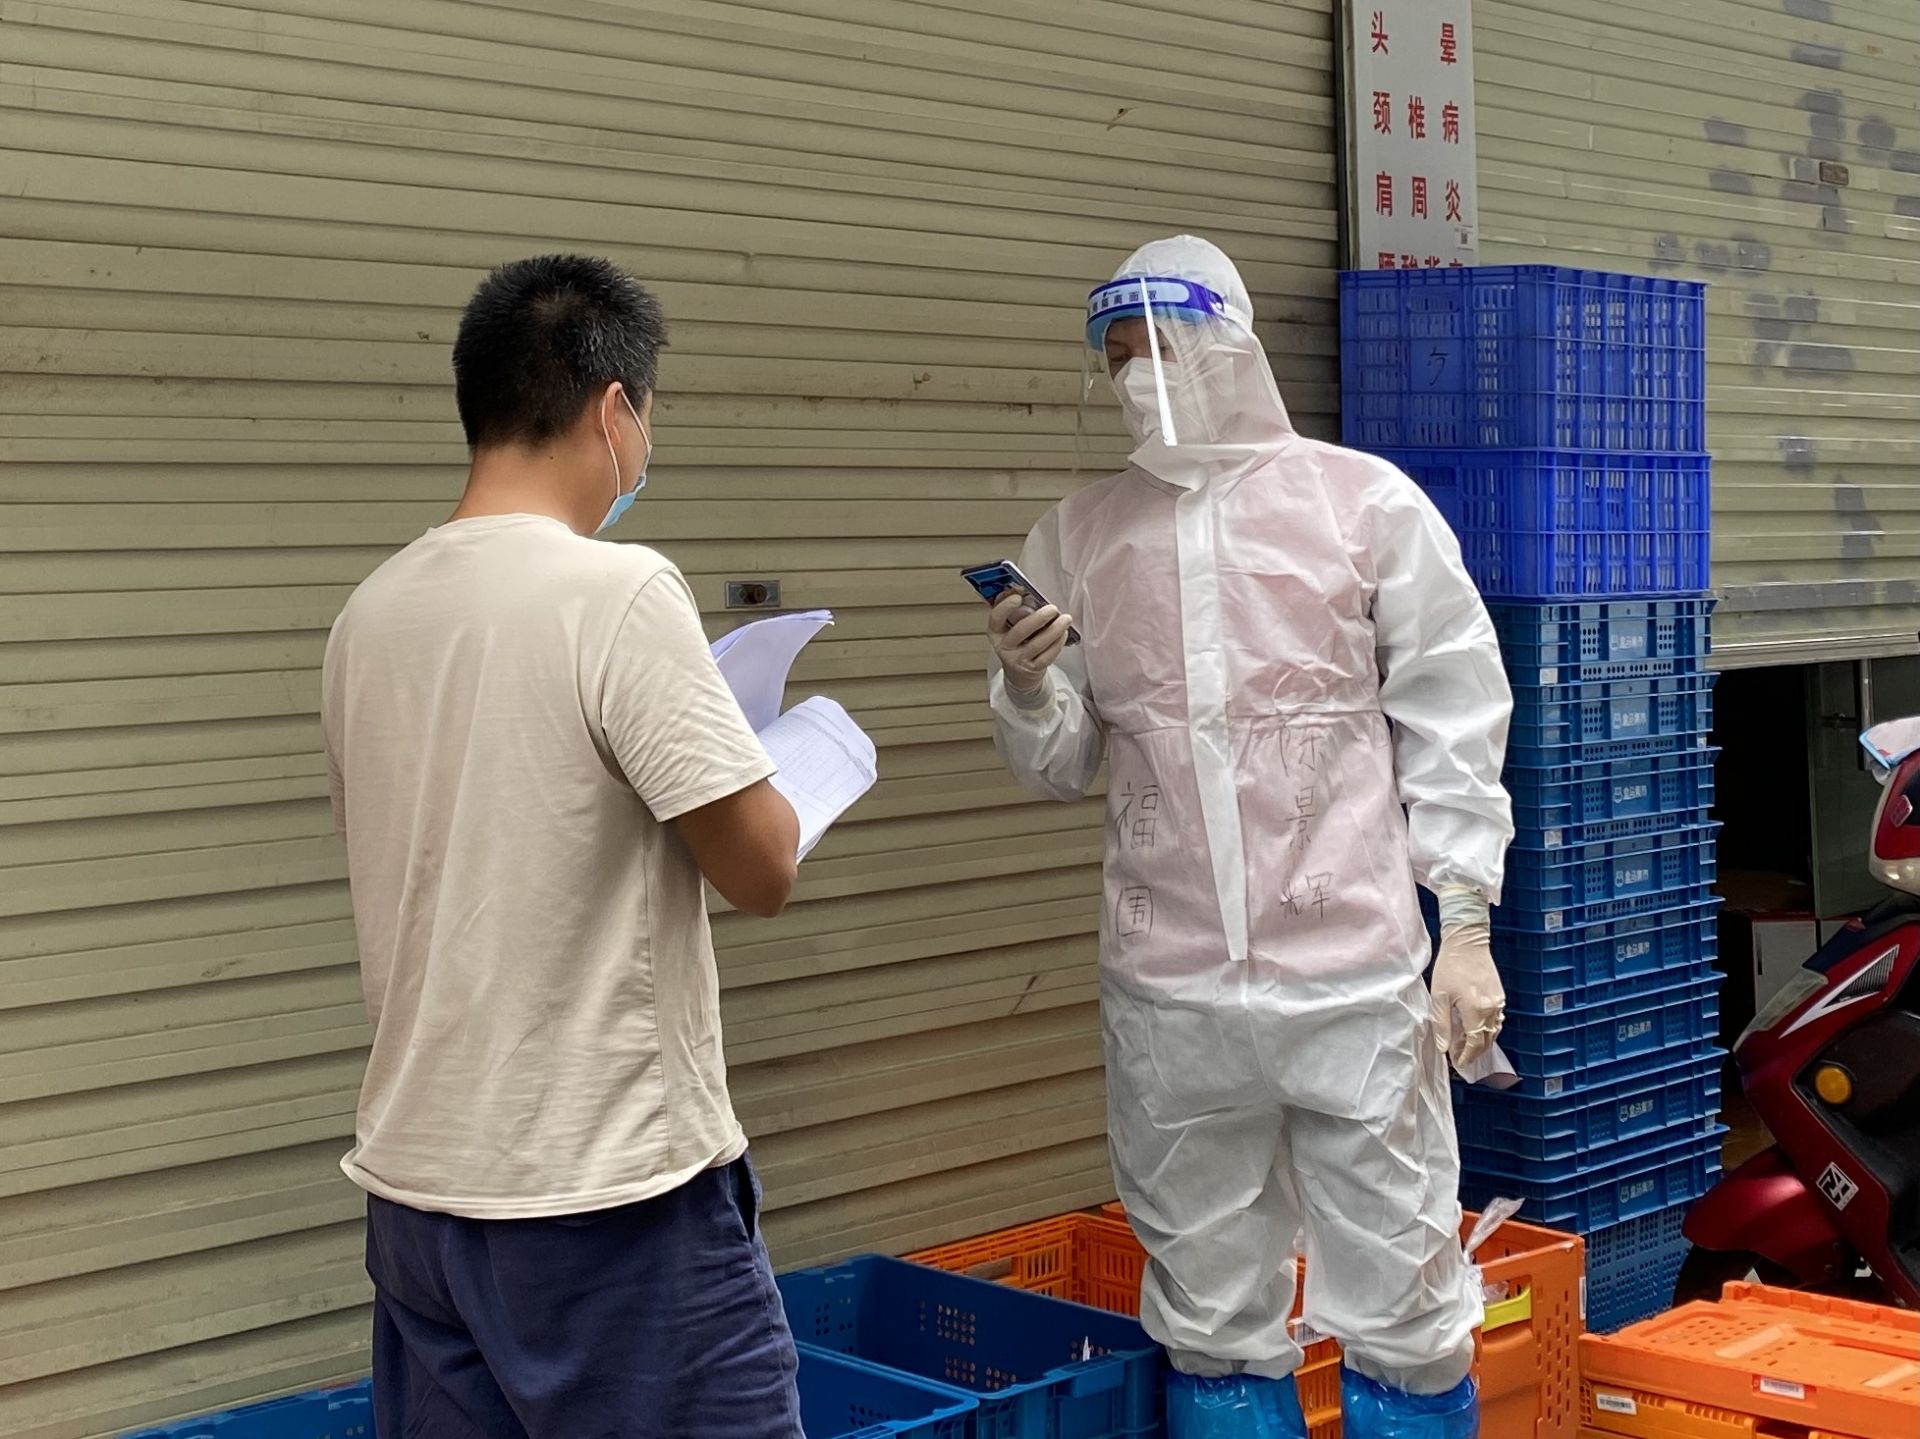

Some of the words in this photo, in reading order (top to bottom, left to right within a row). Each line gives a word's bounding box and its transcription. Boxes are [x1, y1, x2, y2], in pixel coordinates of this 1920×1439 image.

[1371, 11, 1457, 66] 头晕
[1373, 91, 1459, 144] 颈椎病
[1376, 171, 1462, 222] 肩周炎
